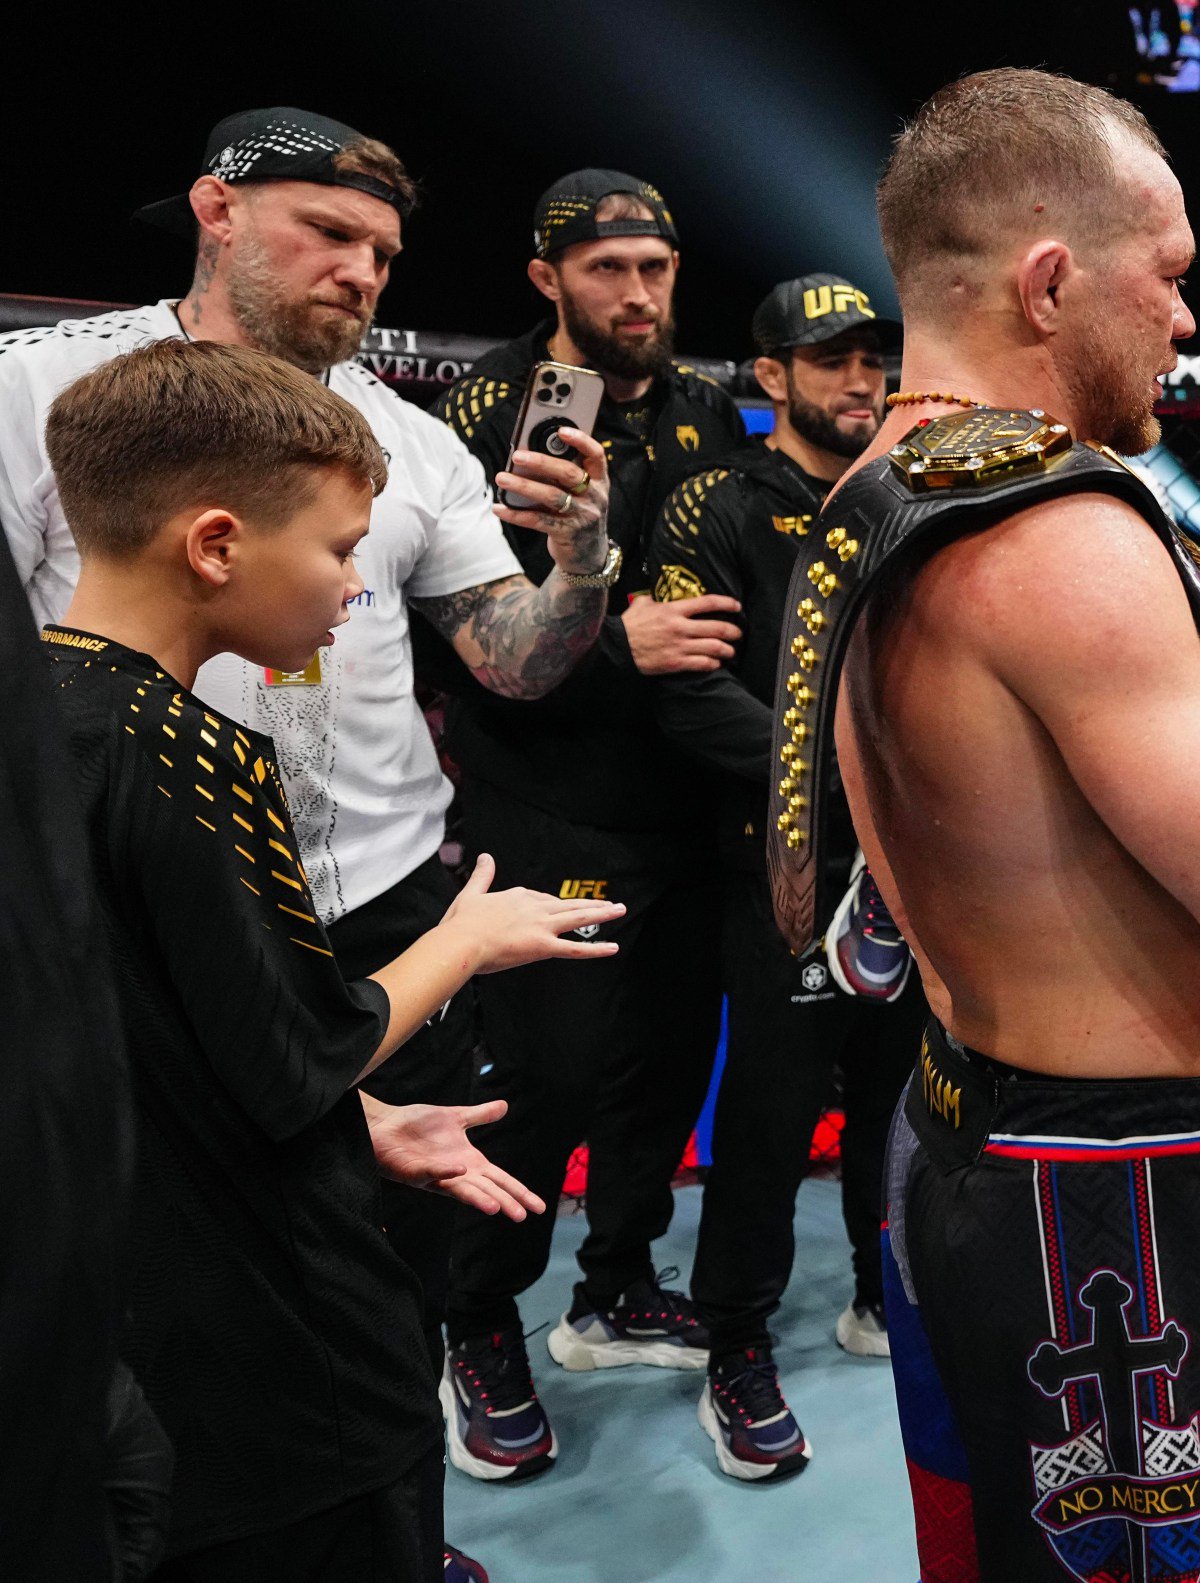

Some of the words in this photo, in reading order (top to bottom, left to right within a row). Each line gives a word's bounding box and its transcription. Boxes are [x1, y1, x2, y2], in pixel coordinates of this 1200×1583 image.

[803, 284, 876, 319] UFC
[361, 327, 418, 354] TI
[352, 352, 473, 384] VELO
[771, 514, 812, 536] UFC
[559, 879, 607, 899] UFC
[1059, 1487, 1103, 1521] NO
[1111, 1479, 1199, 1514] MERCY
